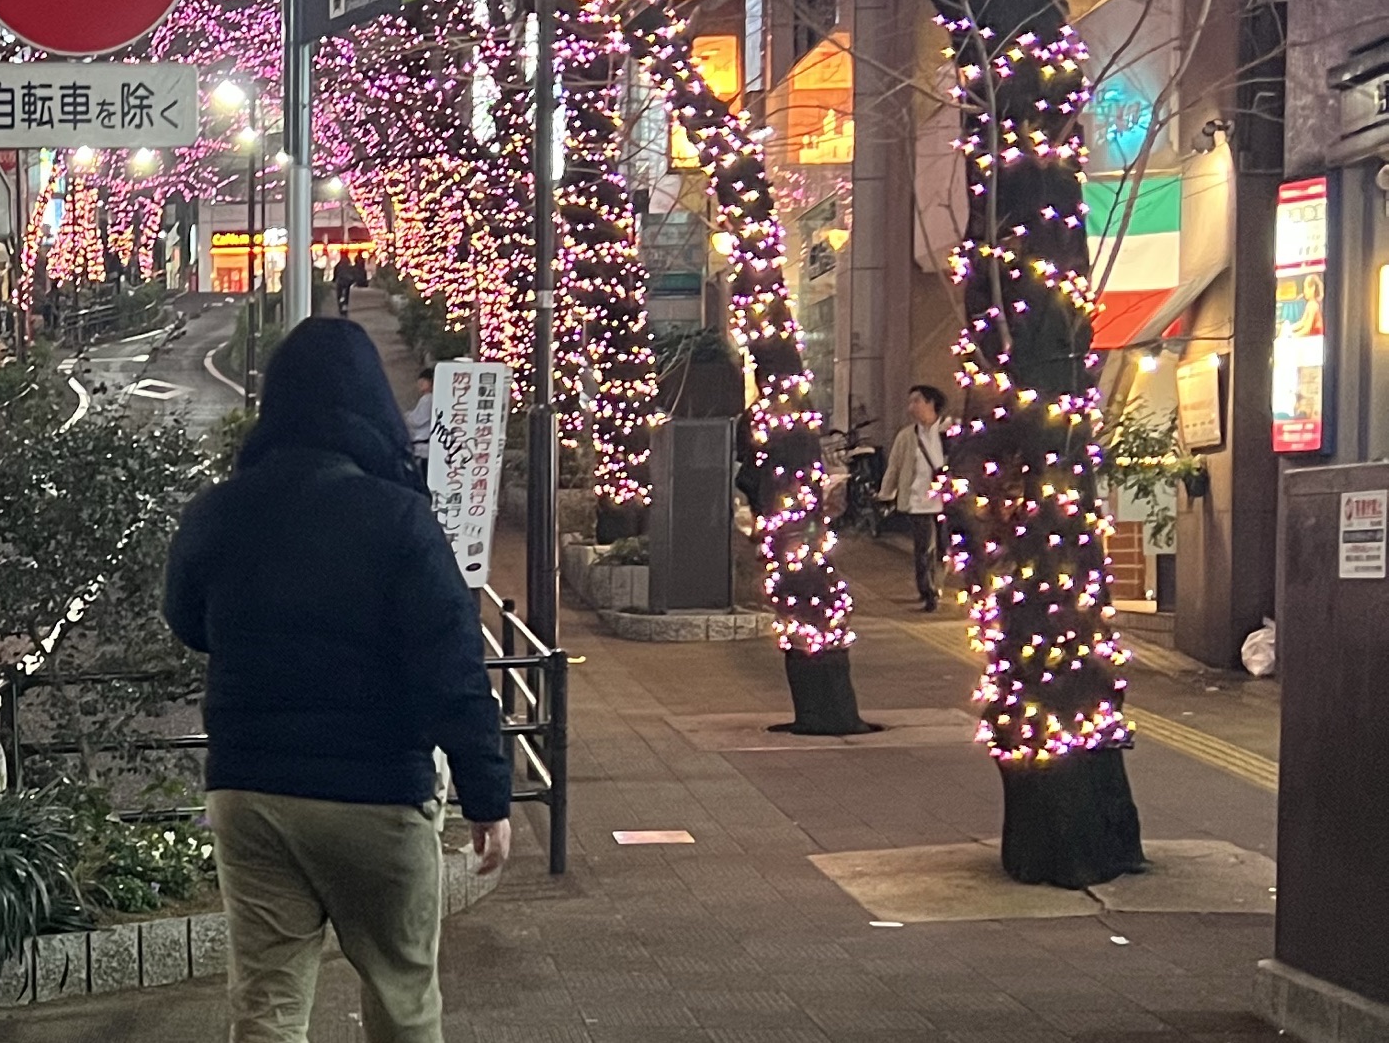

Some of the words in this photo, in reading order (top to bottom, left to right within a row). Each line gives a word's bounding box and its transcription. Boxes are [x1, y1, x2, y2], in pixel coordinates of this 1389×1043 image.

[468, 372, 497, 518] 自転車は歩行者の通行の
